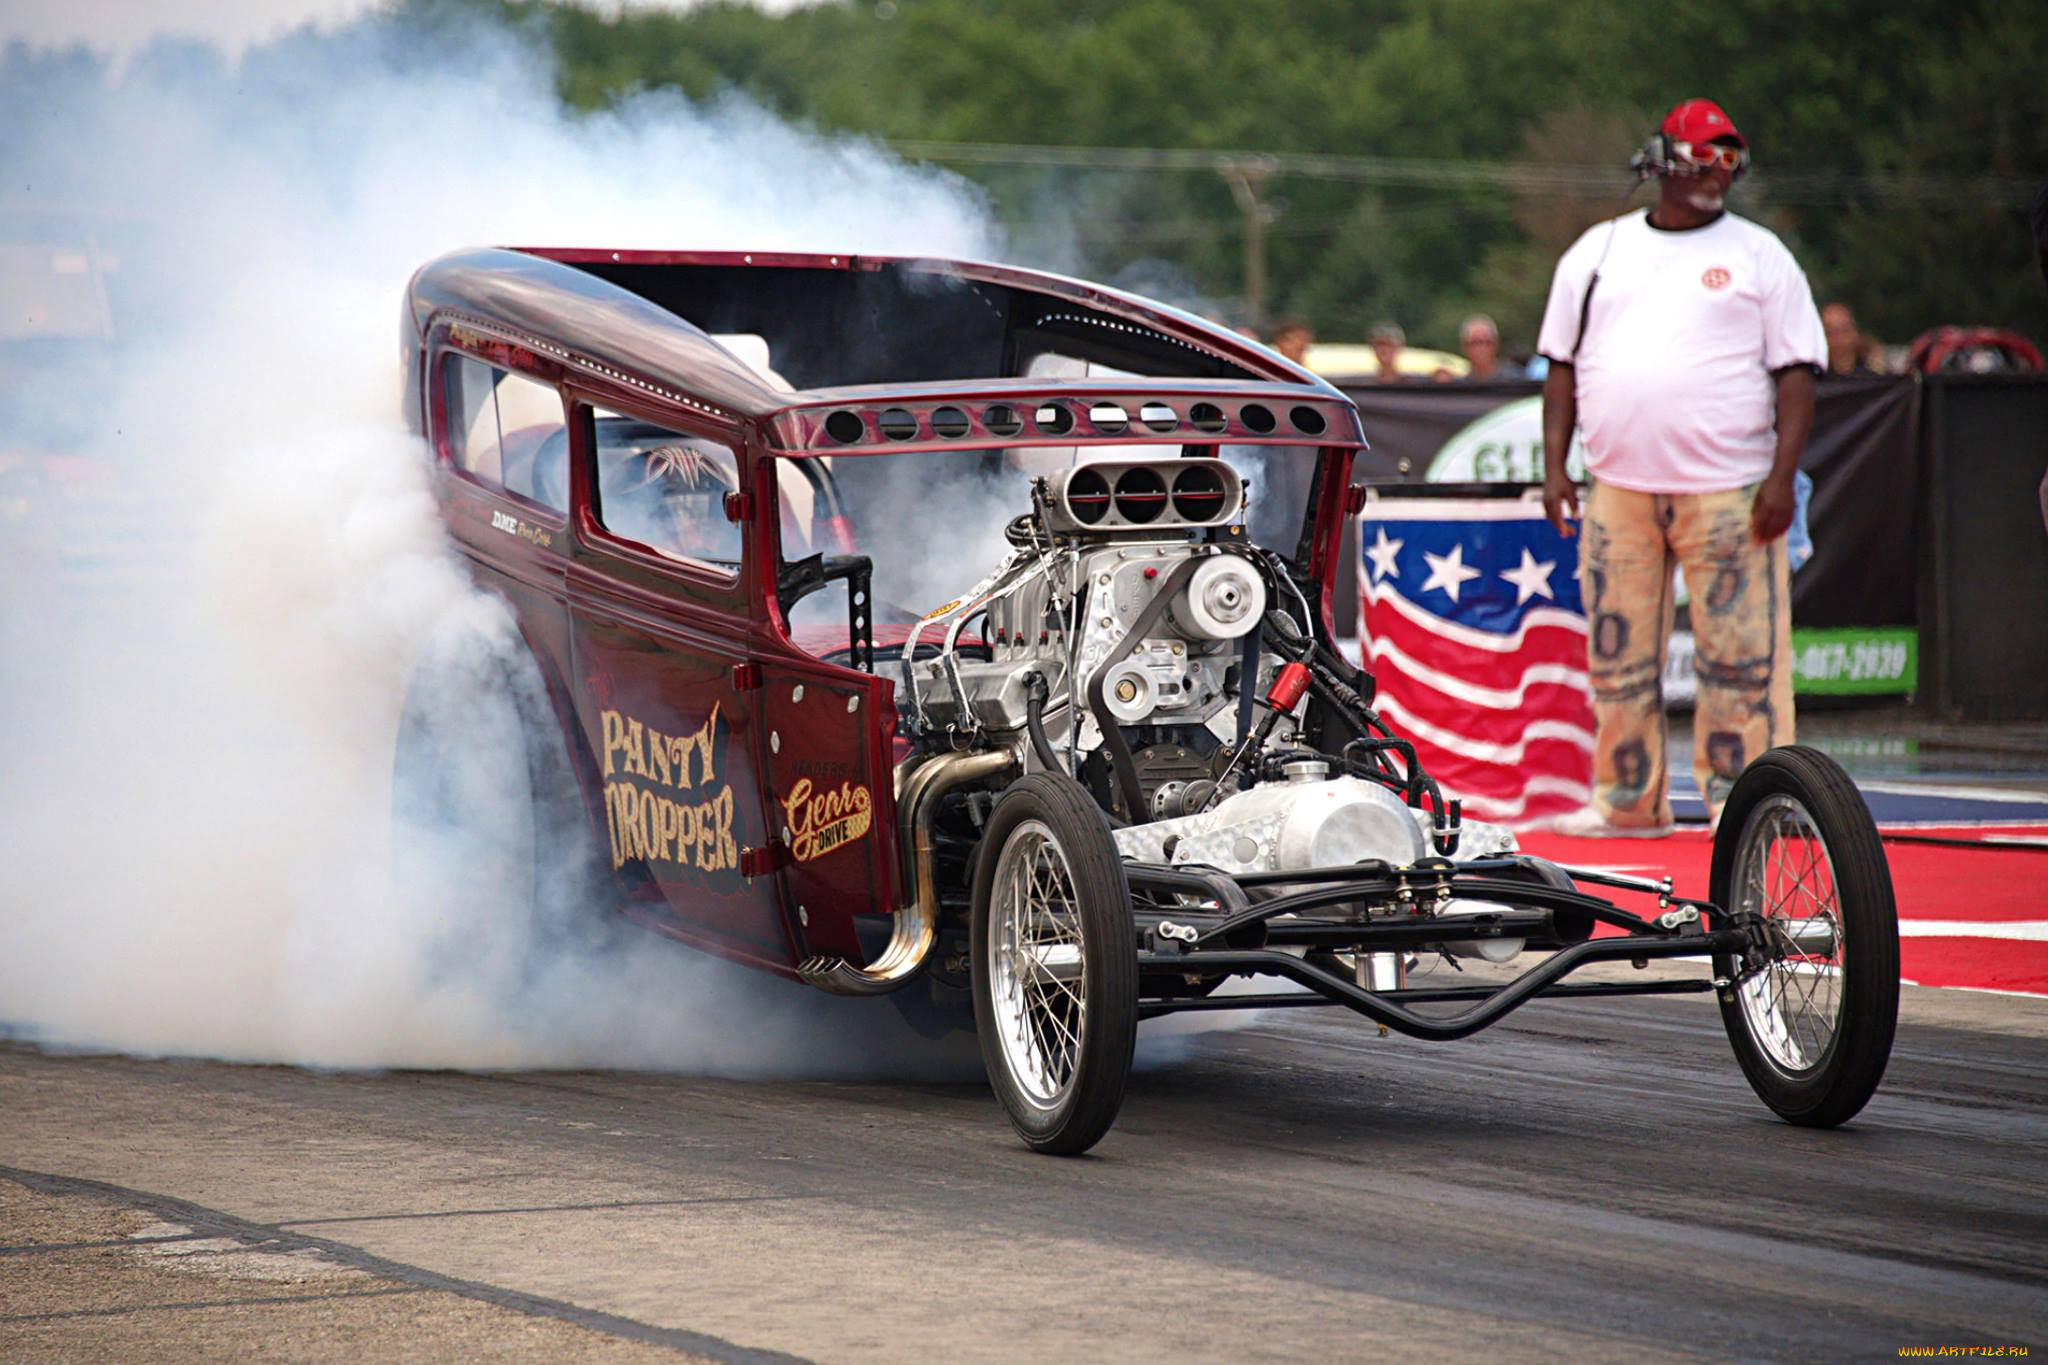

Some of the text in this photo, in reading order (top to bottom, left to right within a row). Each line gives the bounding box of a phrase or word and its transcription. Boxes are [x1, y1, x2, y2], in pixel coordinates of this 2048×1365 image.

[601, 699, 721, 790] PANTY
[603, 781, 737, 872] DROPPER
[817, 820, 849, 851] DRIVE
